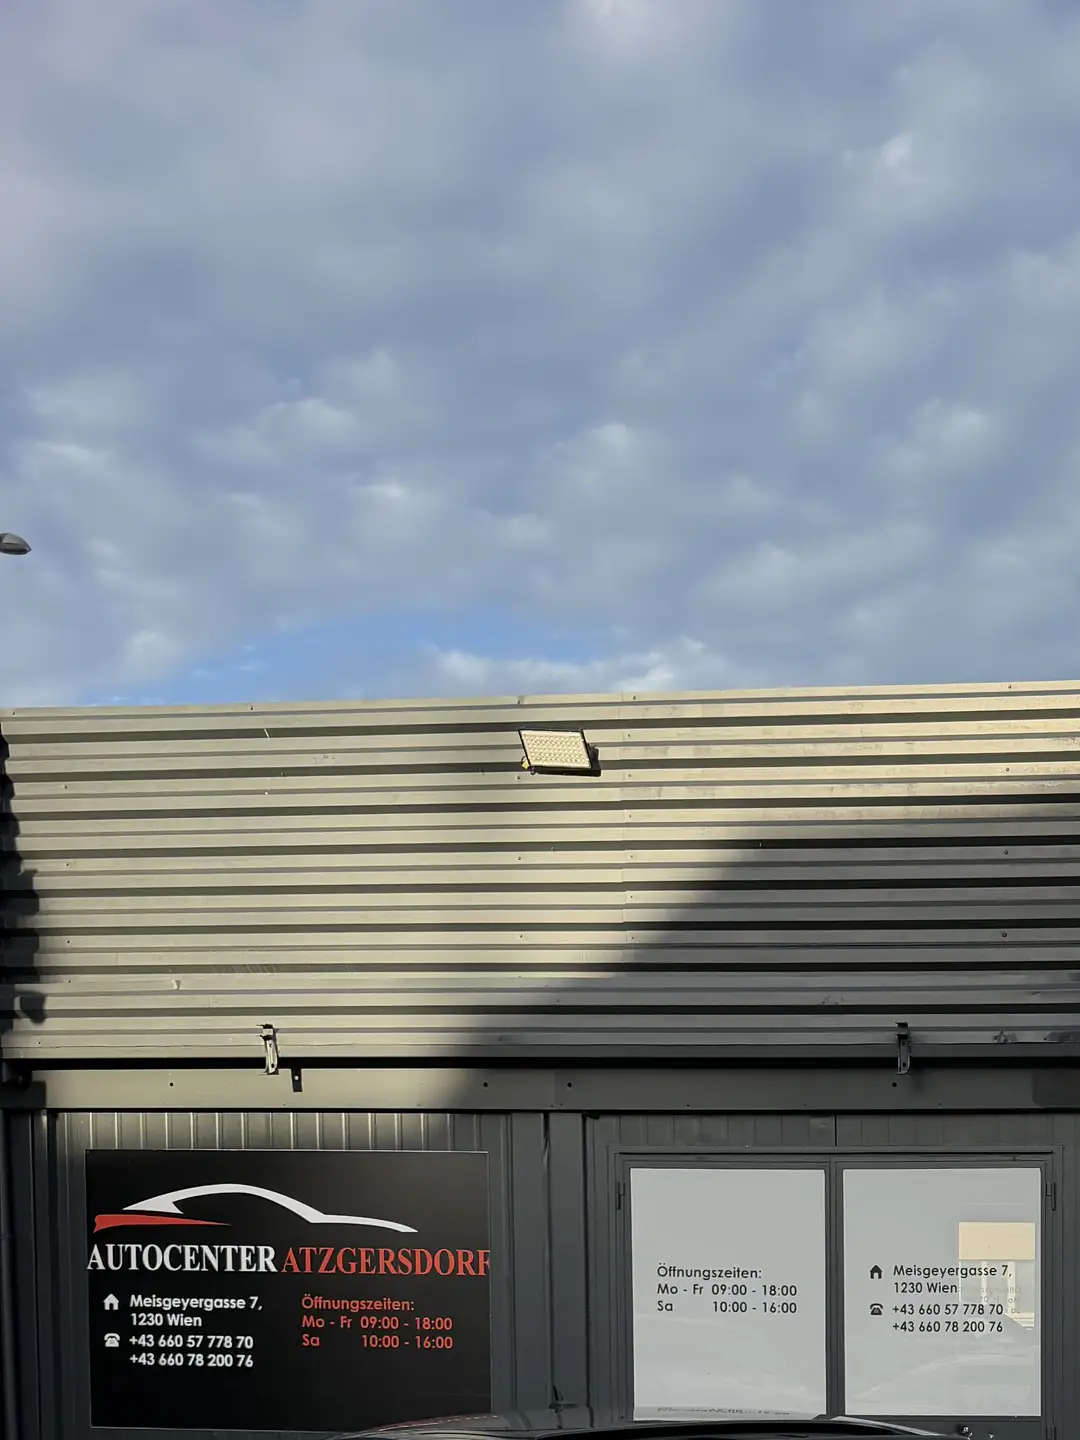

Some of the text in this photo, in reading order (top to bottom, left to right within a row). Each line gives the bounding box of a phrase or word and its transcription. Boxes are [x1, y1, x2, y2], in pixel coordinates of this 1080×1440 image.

[86, 1243, 491, 1276] AUTOCENTER ATZGERSDORF
[656, 1262, 762, 1281] Öffnungszeiten:
[893, 1264, 1013, 1280] Meisgeyergasse 7,
[656, 1283, 679, 1295] Mo
[693, 1283, 704, 1295] Fr
[711, 1283, 747, 1296] 09:00
[761, 1284, 797, 1297] 18:00
[893, 1281, 923, 1294] 1230
[926, 1281, 958, 1294] Wien
[129, 1294, 263, 1312] Meisgeyergasse 7,
[301, 1294, 415, 1313] Öffnungszeiten:
[657, 1300, 673, 1312] Sa
[712, 1301, 748, 1313] 10:00
[761, 1301, 797, 1314] 16:00
[892, 1303, 915, 1315] +43
[918, 1303, 941, 1315] 660
[944, 1303, 959, 1315] 57
[963, 1303, 985, 1316] 778
[989, 1303, 1004, 1316] 70
[131, 1312, 202, 1327] 1230 Wien
[302, 1316, 325, 1329] Mo
[340, 1315, 352, 1329] Fr
[360, 1315, 399, 1330] 09:00
[414, 1316, 453, 1331] 18:00
[892, 1320, 1003, 1333] +43 660 78 200 76
[129, 1333, 254, 1349] +43 660 57 778 70
[302, 1333, 320, 1347] Sa
[361, 1334, 400, 1348] 10:00
[414, 1335, 453, 1349] 16:00
[129, 1352, 254, 1368] +43 660 78 200 76
